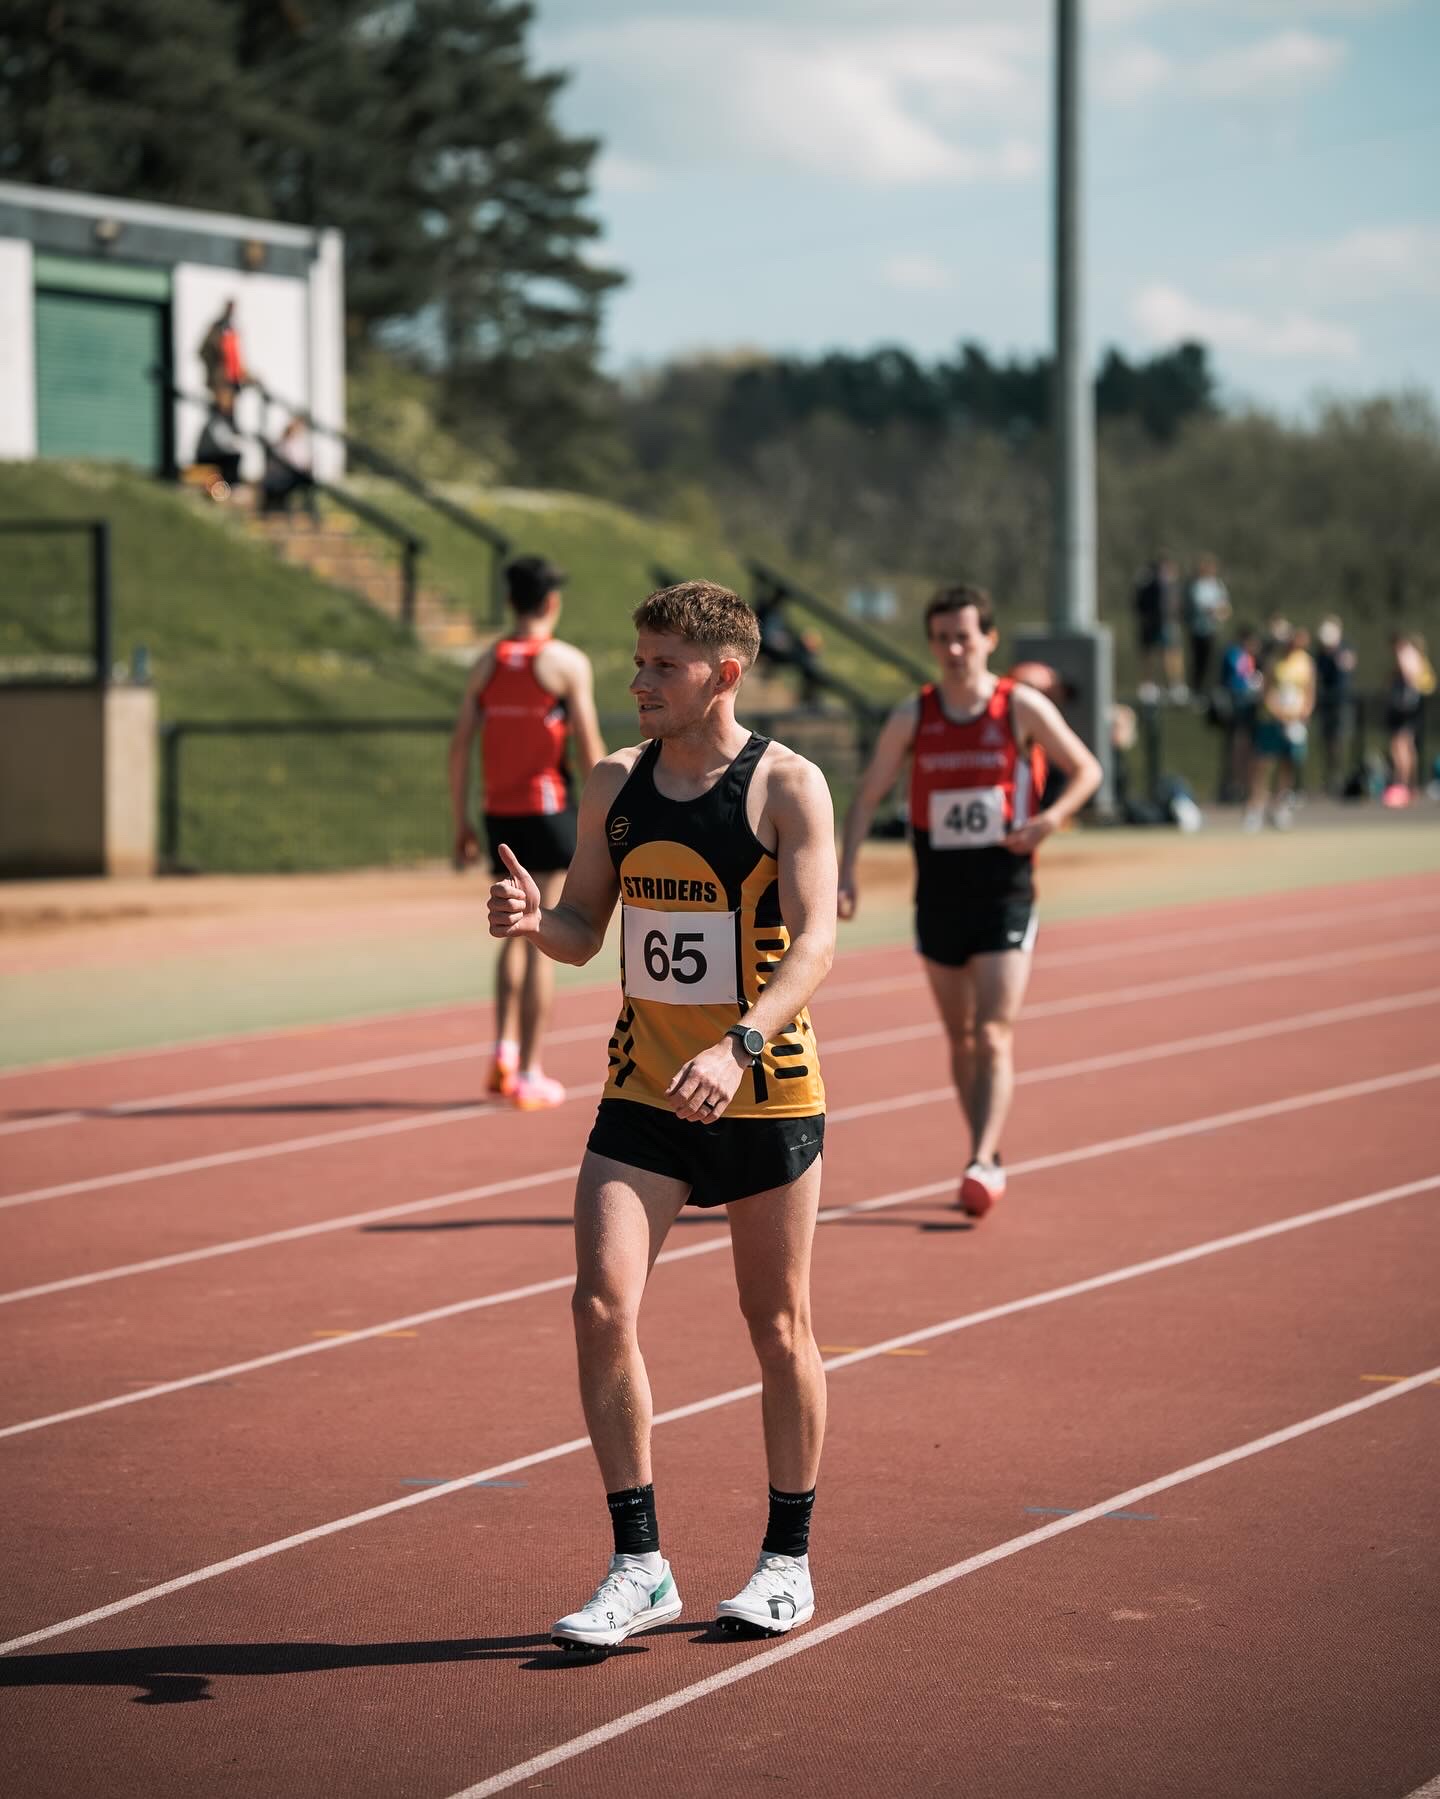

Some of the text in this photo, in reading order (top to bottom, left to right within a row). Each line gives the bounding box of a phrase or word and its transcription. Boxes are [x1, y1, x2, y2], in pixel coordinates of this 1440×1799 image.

[944, 801, 988, 834] 46
[624, 876, 718, 904] STRIDERS
[643, 929, 708, 985] 65
